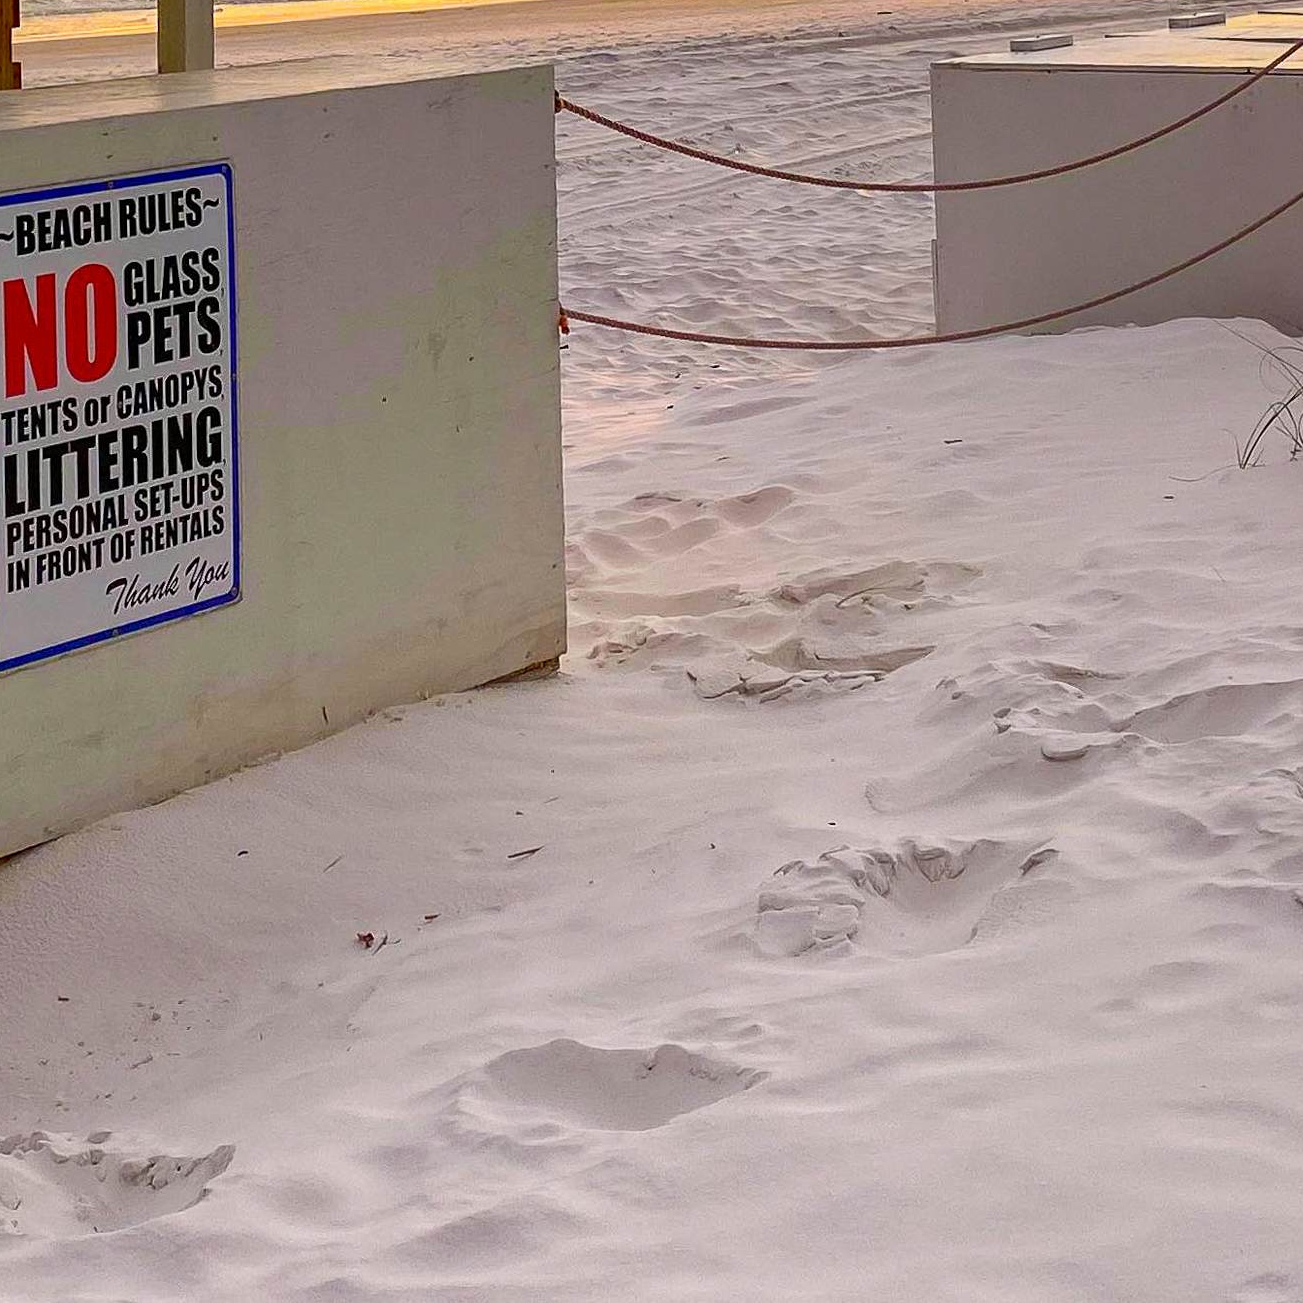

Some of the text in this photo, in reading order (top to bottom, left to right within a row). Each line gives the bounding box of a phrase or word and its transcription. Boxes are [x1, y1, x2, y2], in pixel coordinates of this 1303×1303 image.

[3, 263, 117, 398] NO
[1, 397, 78, 446] TENTS
[84, 395, 111, 427] or
[7, 469, 224, 556] PERSONAL SET-UPS
[7, 506, 225, 593] IN FRONT OF RENTALS
[106, 556, 229, 615] Thank You
